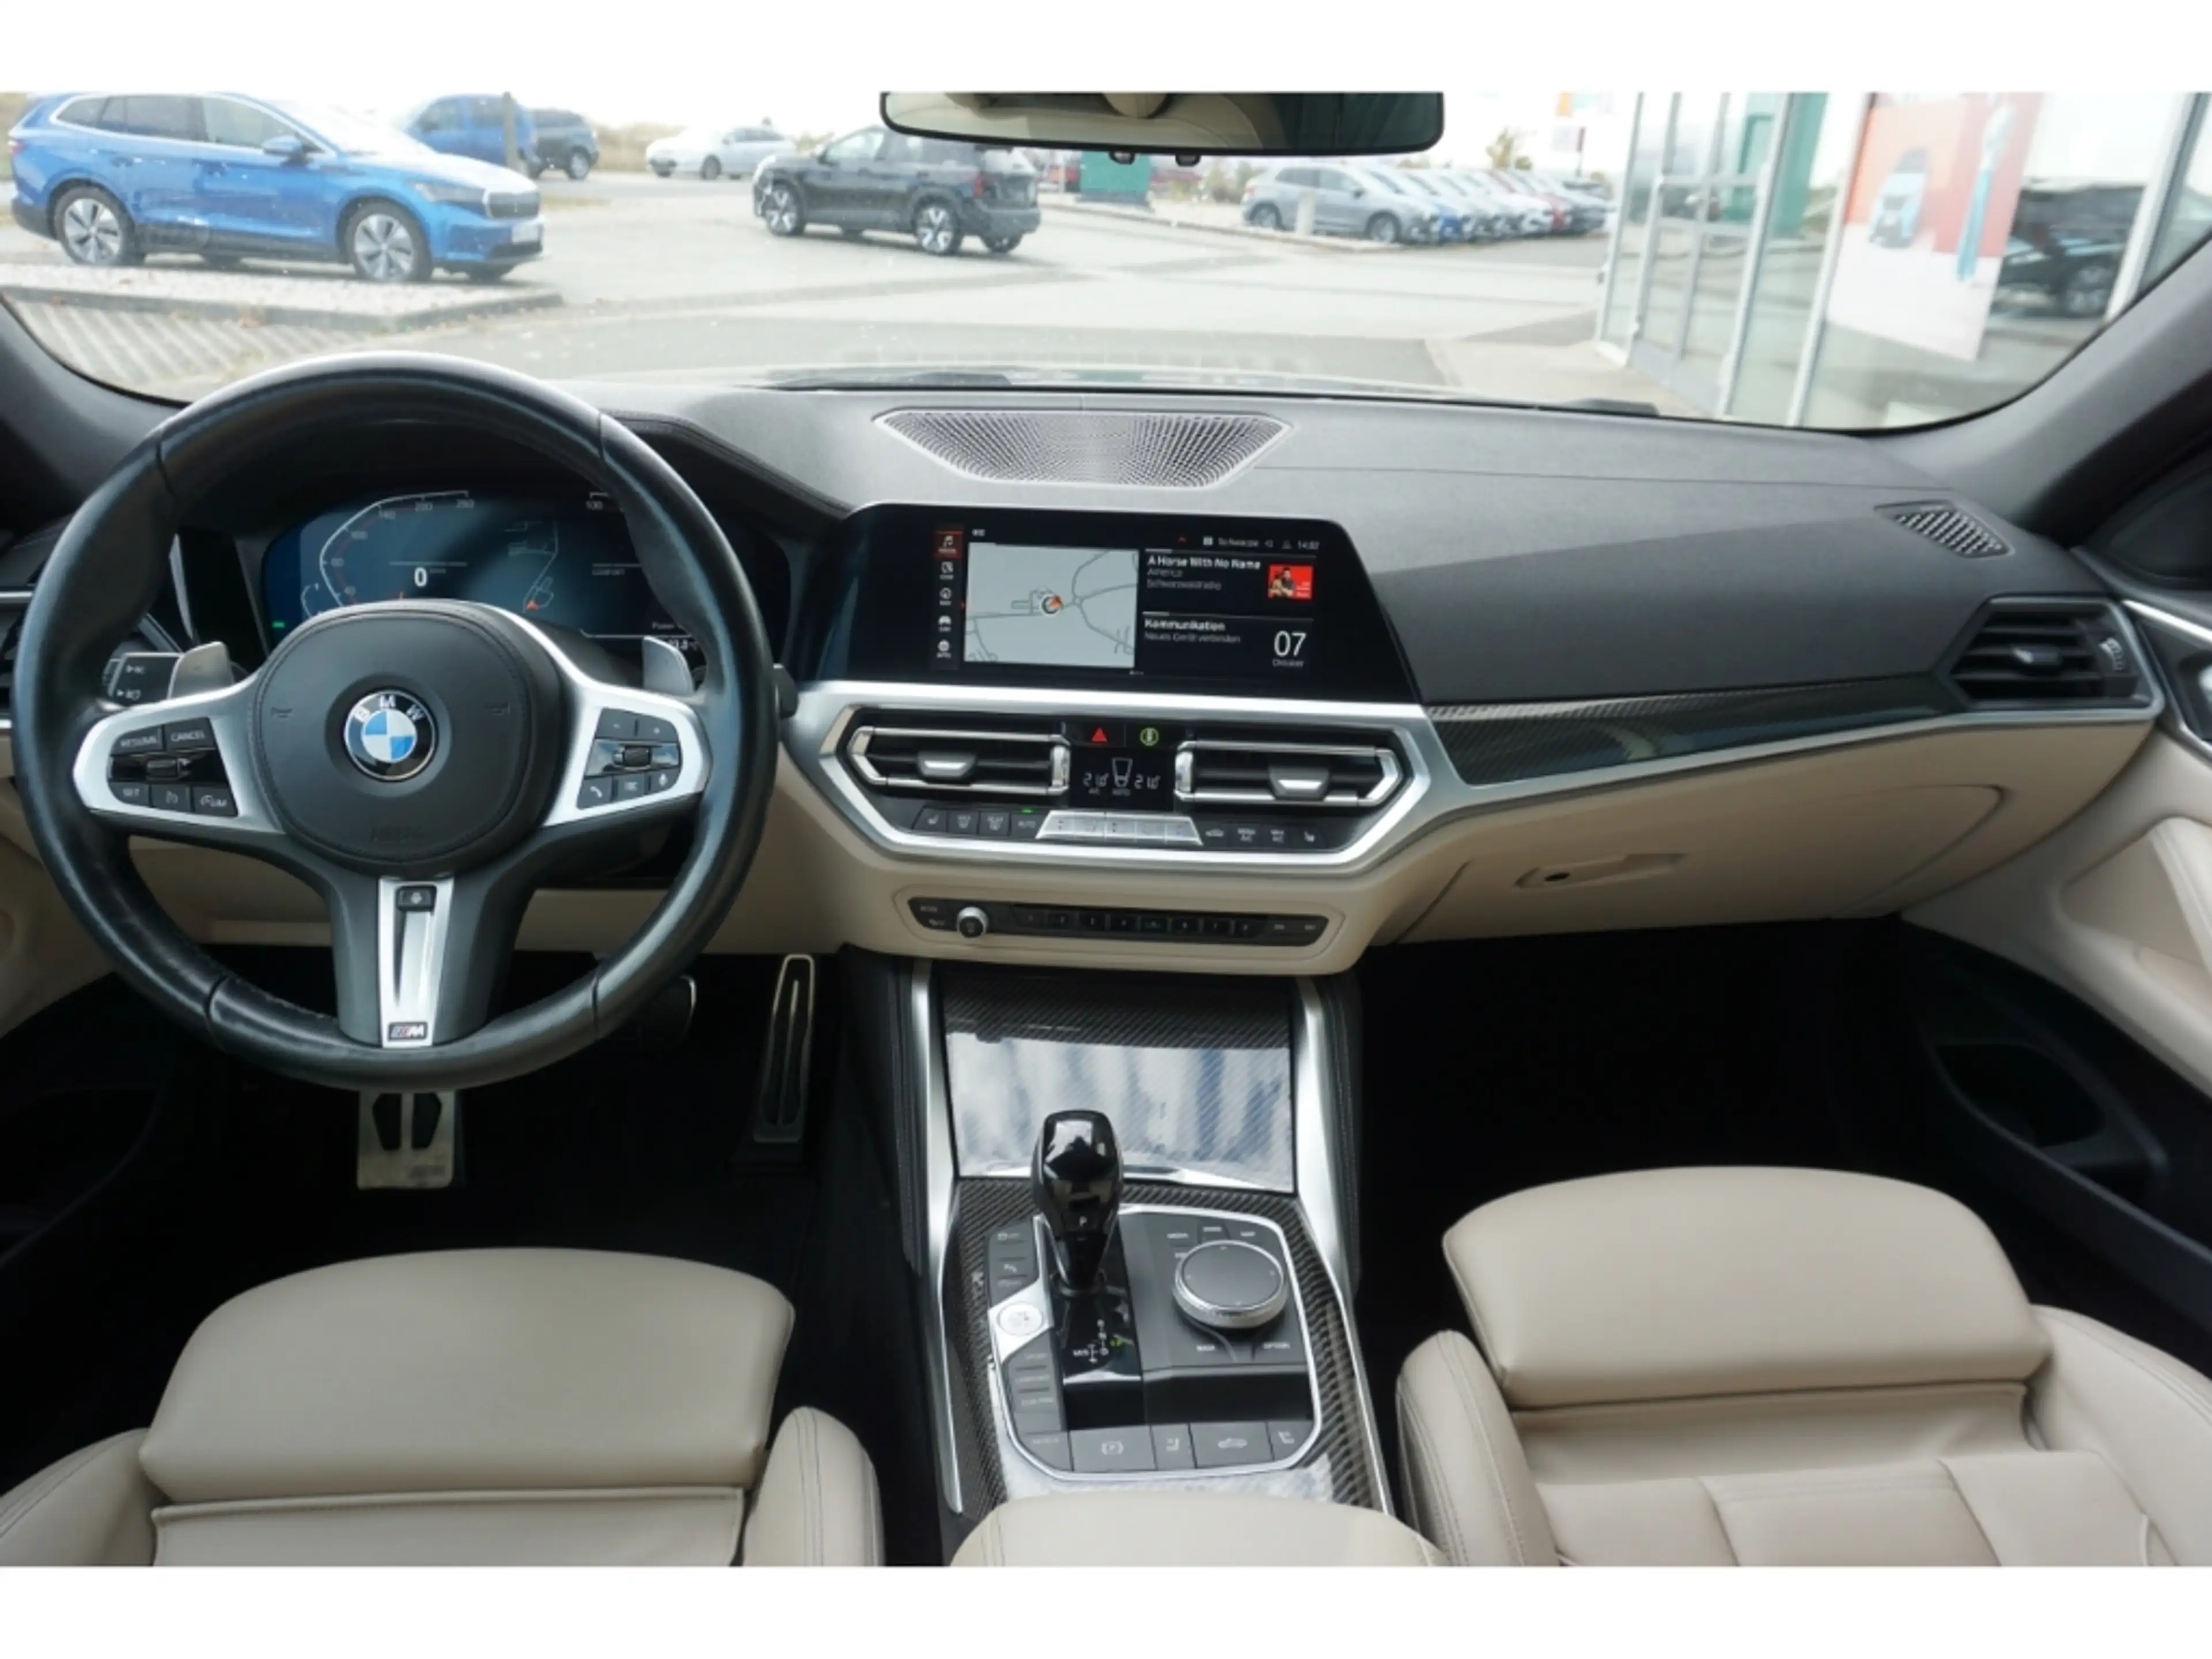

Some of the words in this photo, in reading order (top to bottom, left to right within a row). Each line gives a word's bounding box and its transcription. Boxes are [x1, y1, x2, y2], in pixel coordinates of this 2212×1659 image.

[1147, 555, 1156, 565] A
[1157, 556, 1187, 567] Horse
[1190, 557, 1213, 567] With
[1214, 558, 1229, 569] No
[1231, 559, 1260, 570] Name
[414, 567, 427, 587] 0
[1144, 619, 1226, 631] Kommunikation
[1274, 630, 1306, 657] 07
[353, 695, 425, 722] BMW
[171, 731, 205, 742] CANCEL
